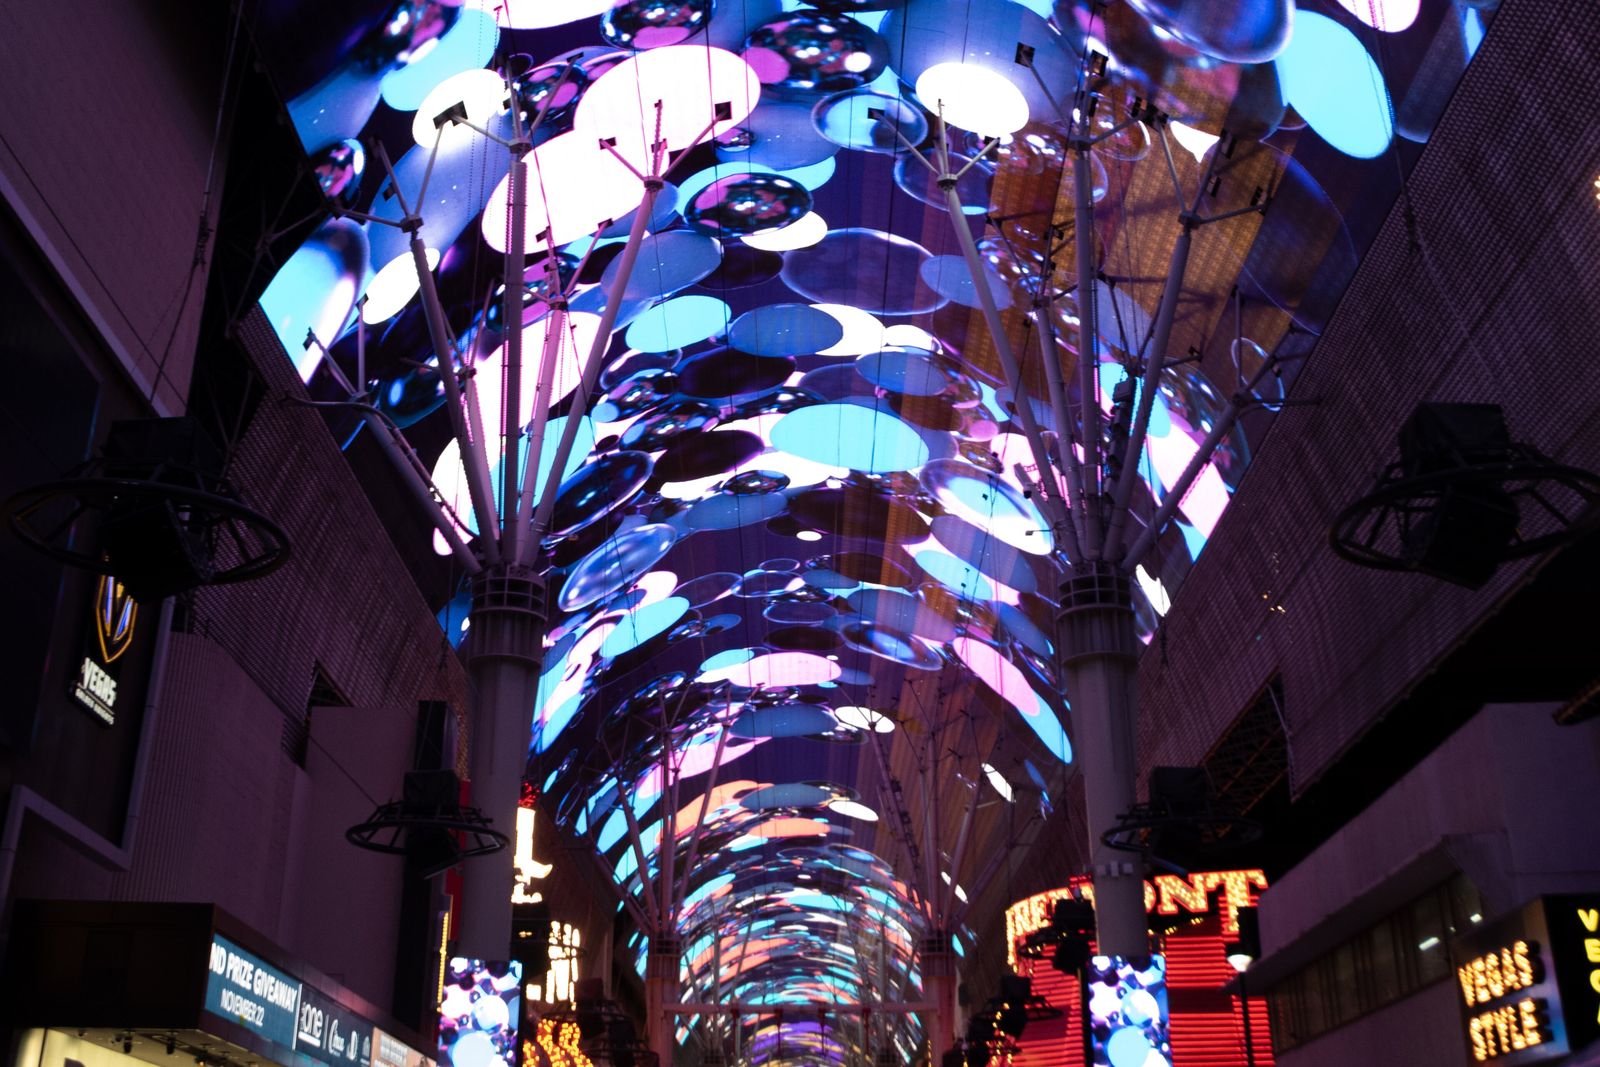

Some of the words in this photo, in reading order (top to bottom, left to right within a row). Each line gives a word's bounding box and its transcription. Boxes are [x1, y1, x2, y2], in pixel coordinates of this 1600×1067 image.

[83, 657, 117, 707] VEGAS
[225, 952, 254, 990] PRIZE
[253, 968, 298, 1013] GIVEAWAY
[1458, 939, 1533, 1008] VEGAS
[220, 988, 257, 1023] NOVEMBER
[255, 1004, 265, 1027] 22
[1469, 997, 1542, 1062] STYLE
